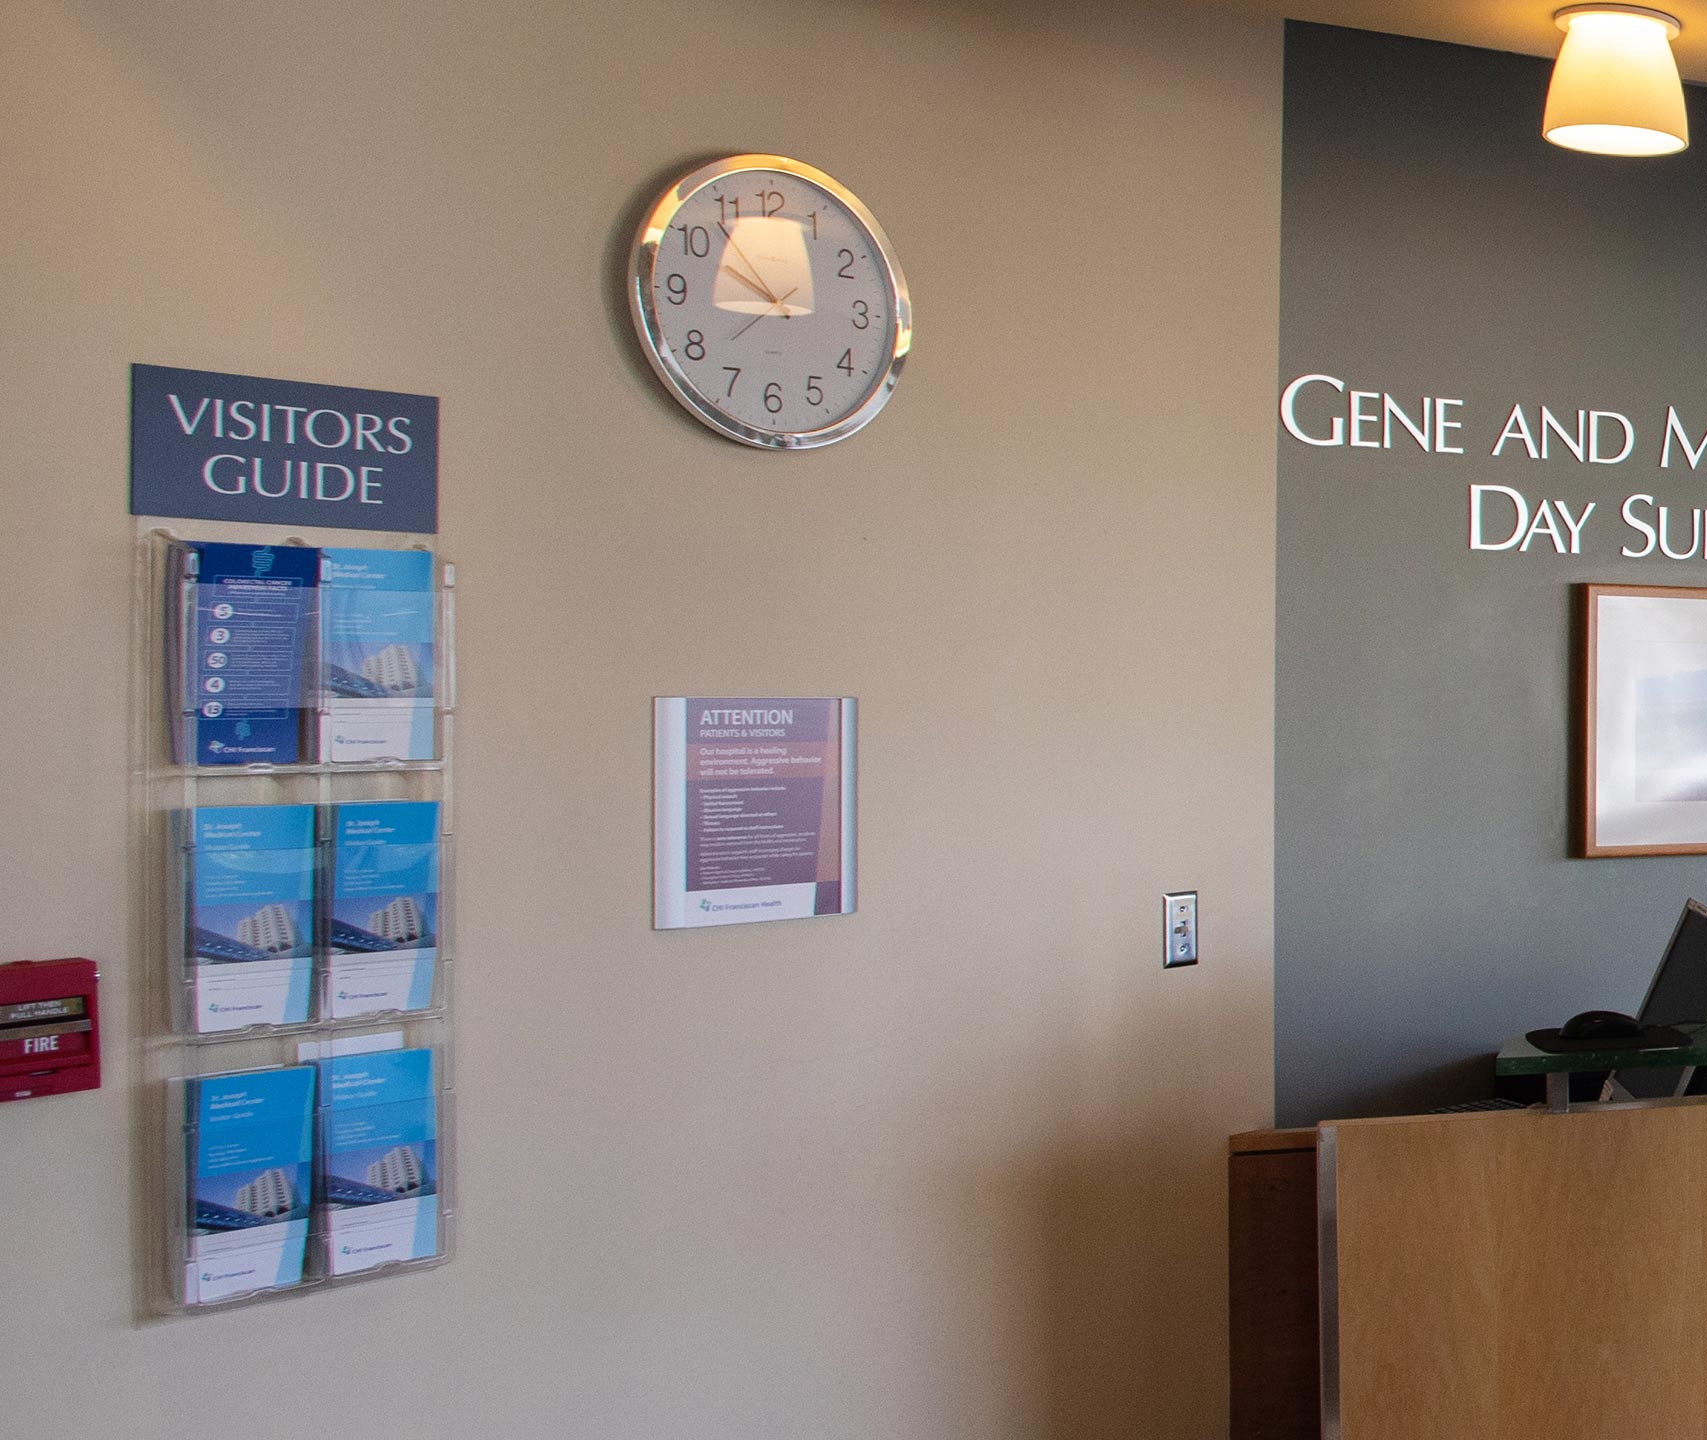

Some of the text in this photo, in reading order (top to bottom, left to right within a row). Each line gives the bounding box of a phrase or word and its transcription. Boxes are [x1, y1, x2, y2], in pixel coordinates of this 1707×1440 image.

[715, 194, 740, 225] 11
[755, 191, 785, 218] 12
[808, 211, 818, 240] 1
[678, 224, 710, 258] 10
[838, 249, 854, 279] 2
[667, 273, 687, 305] 9
[852, 300, 869, 329] 3
[685, 330, 705, 360] 8
[837, 348, 854, 377] 4
[723, 367, 741, 397] 7
[806, 376, 823, 405] 5
[764, 383, 782, 413] 6
[168, 393, 413, 456] VISITORS
[1280, 374, 1464, 454] GENE
[1491, 403, 1635, 465] AND
[202, 454, 384, 504] GUIDE
[1470, 484, 1596, 554] DAY
[211, 655, 225, 665] 50
[210, 680, 219, 690] 4
[700, 709, 794, 726] ATTENTION
[700, 729, 740, 738] PATIENTS
[749, 728, 786, 738] VISITORS
[35, 1006, 69, 1016] HANDLE
[24, 1035, 59, 1054] FIRE
